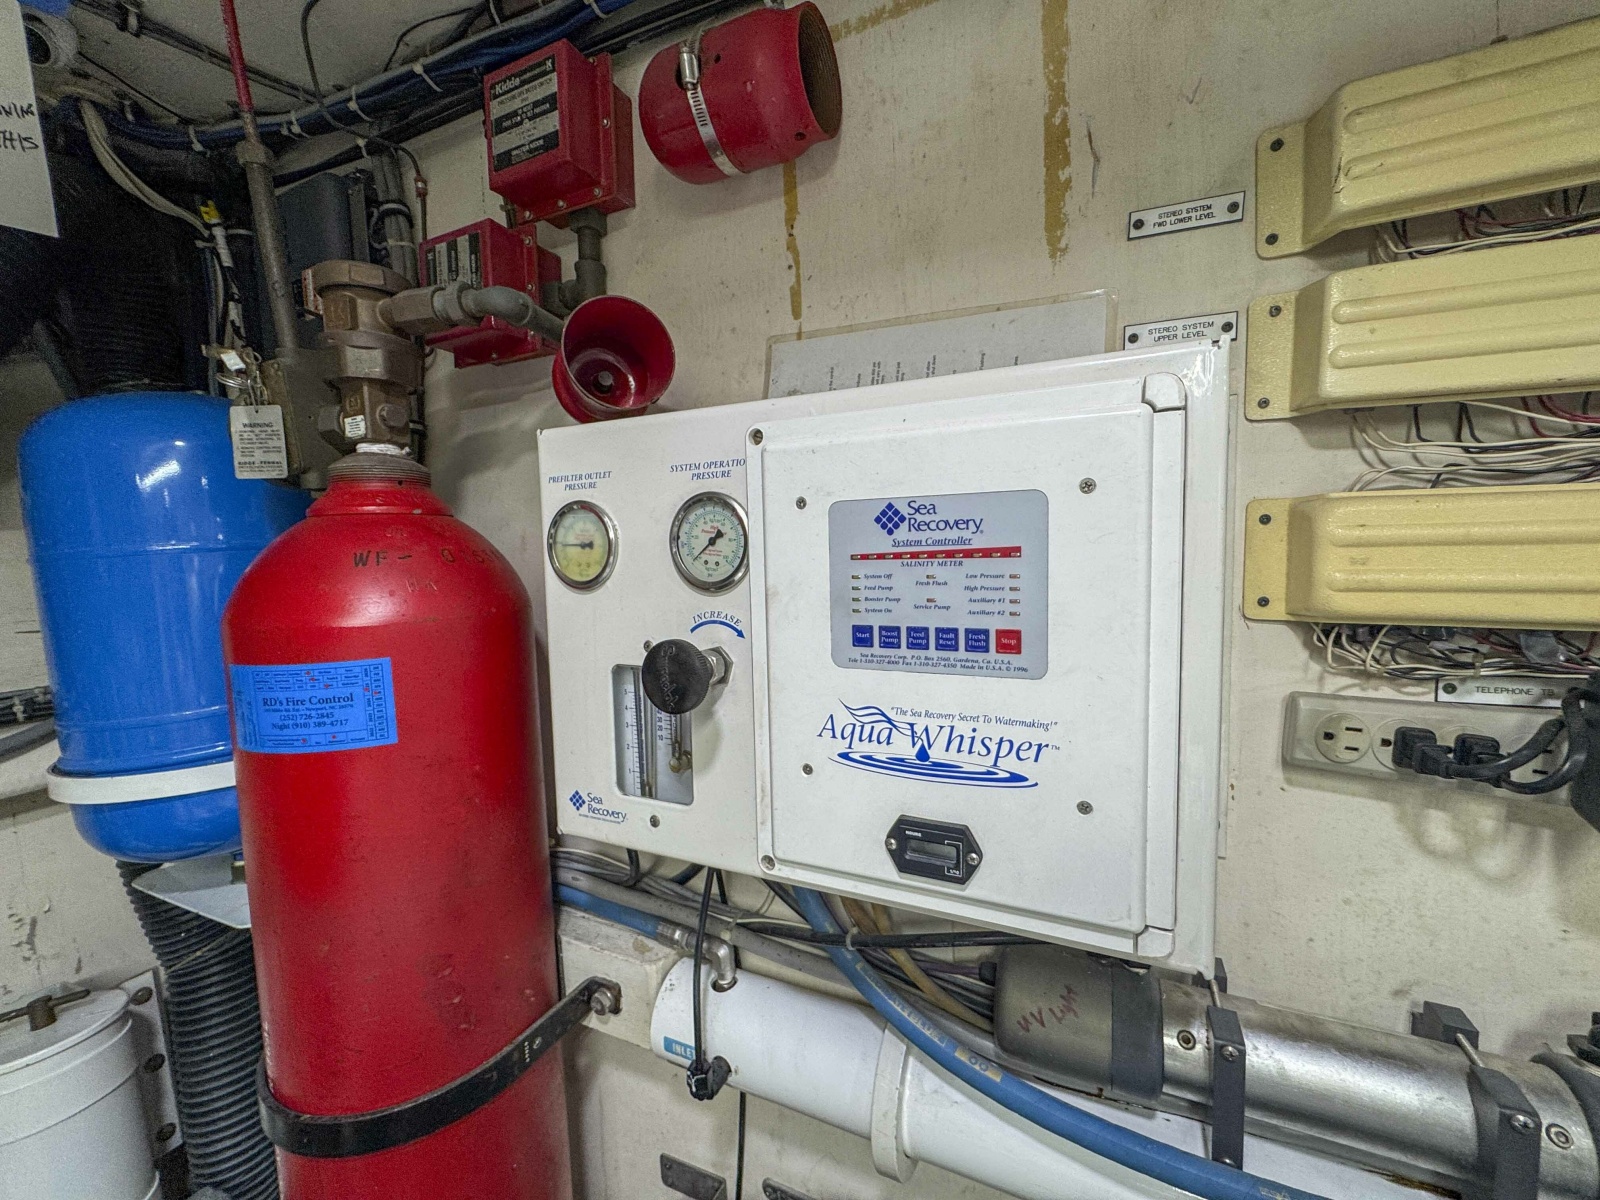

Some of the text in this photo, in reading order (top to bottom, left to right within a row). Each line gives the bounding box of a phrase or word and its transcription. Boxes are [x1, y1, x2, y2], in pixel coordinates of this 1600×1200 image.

[1158, 204, 1212, 220] STEREO SYSTEM
[1153, 211, 1216, 229] FWD LOWER LEVEL
[1148, 321, 1215, 336] STEREO SYSTEM
[1153, 330, 1207, 342] UPPER LEVEL
[670, 458, 746, 473] SYSTEM OPERATIO
[548, 470, 612, 484] PREFILTER OUTLET
[691, 470, 732, 481] PRESSURE
[564, 481, 598, 491] PRESSURE
[907, 500, 937, 516] Sea
[907, 517, 984, 535] Recovery
[891, 536, 973, 548] System Controller
[900, 560, 964, 568] SALINITY METER
[692, 610, 742, 627] INCREASE
[908, 637, 927, 645] Pump
[1000, 637, 1017, 646] Stop
[1475, 685, 1535, 696] TELEPHONE
[262, 692, 354, 707] RD's Fire Control
[299, 711, 335, 721] 726-2845
[909, 708, 922, 718] Sea
[924, 709, 956, 723] Recovery
[957, 712, 980, 723] Secret
[982, 714, 992, 724] To
[271, 722, 290, 731] Night
[816, 713, 894, 750] Aqua
[907, 722, 1049, 768] Whisper
[587, 792, 604, 805] Sea
[587, 803, 627, 823] Recovery
